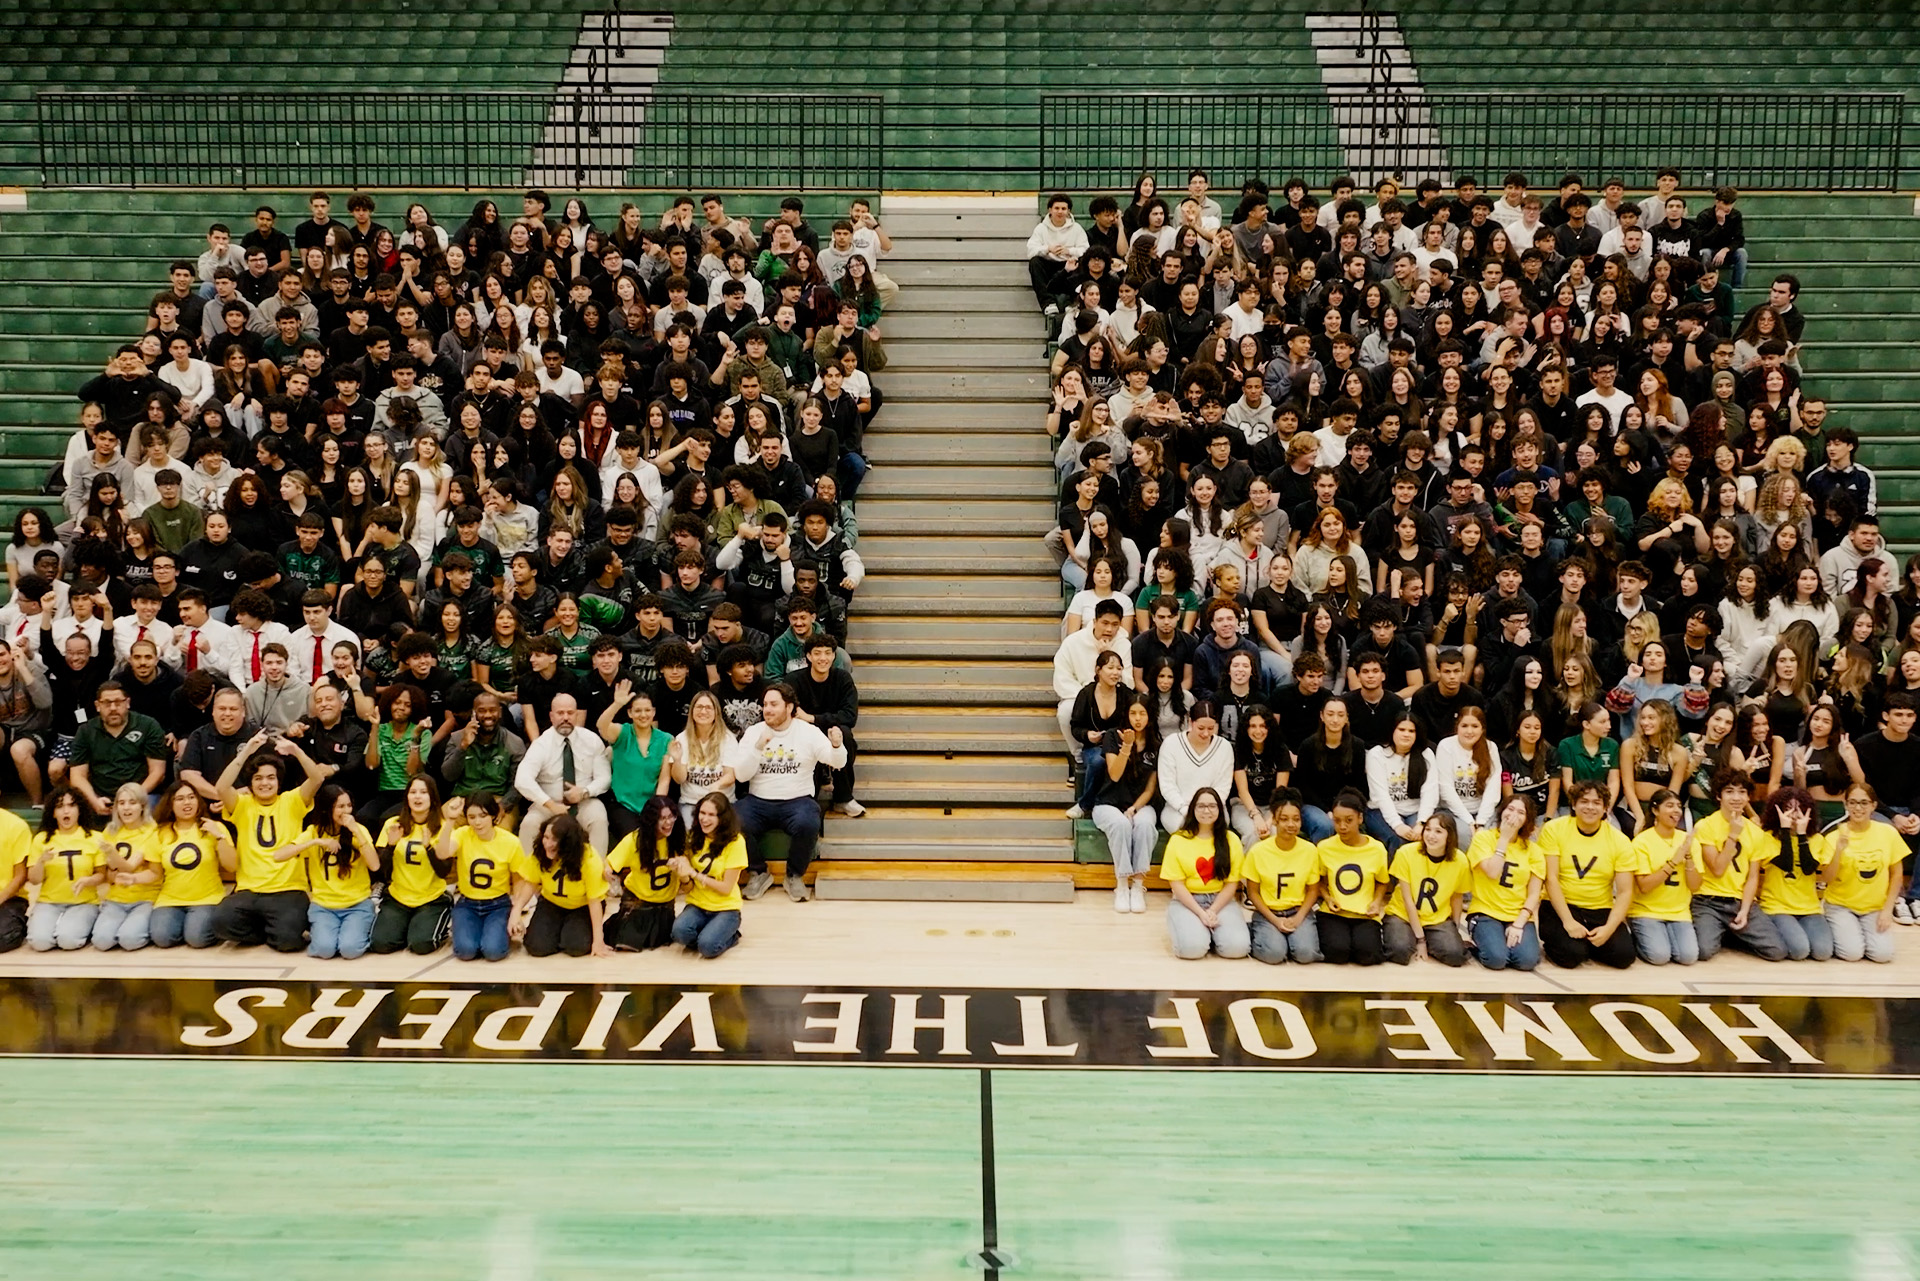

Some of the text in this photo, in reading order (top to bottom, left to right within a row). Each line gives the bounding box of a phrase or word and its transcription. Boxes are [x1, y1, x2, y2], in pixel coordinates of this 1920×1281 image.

[1238, 421, 1269, 445] 26
[257, 815, 277, 847] U
[59, 850, 82, 880] T
[170, 843, 201, 870] O
[405, 841, 421, 865] E
[469, 858, 495, 889] 6
[1336, 864, 1364, 895] O
[1500, 862, 1519, 888] E
[1571, 855, 1598, 880] V
[552, 870, 568, 897] 1
[1277, 873, 1295, 899] F
[1416, 877, 1438, 913] R
[180, 988, 1824, 1064] HOME OF THE VIPERS
